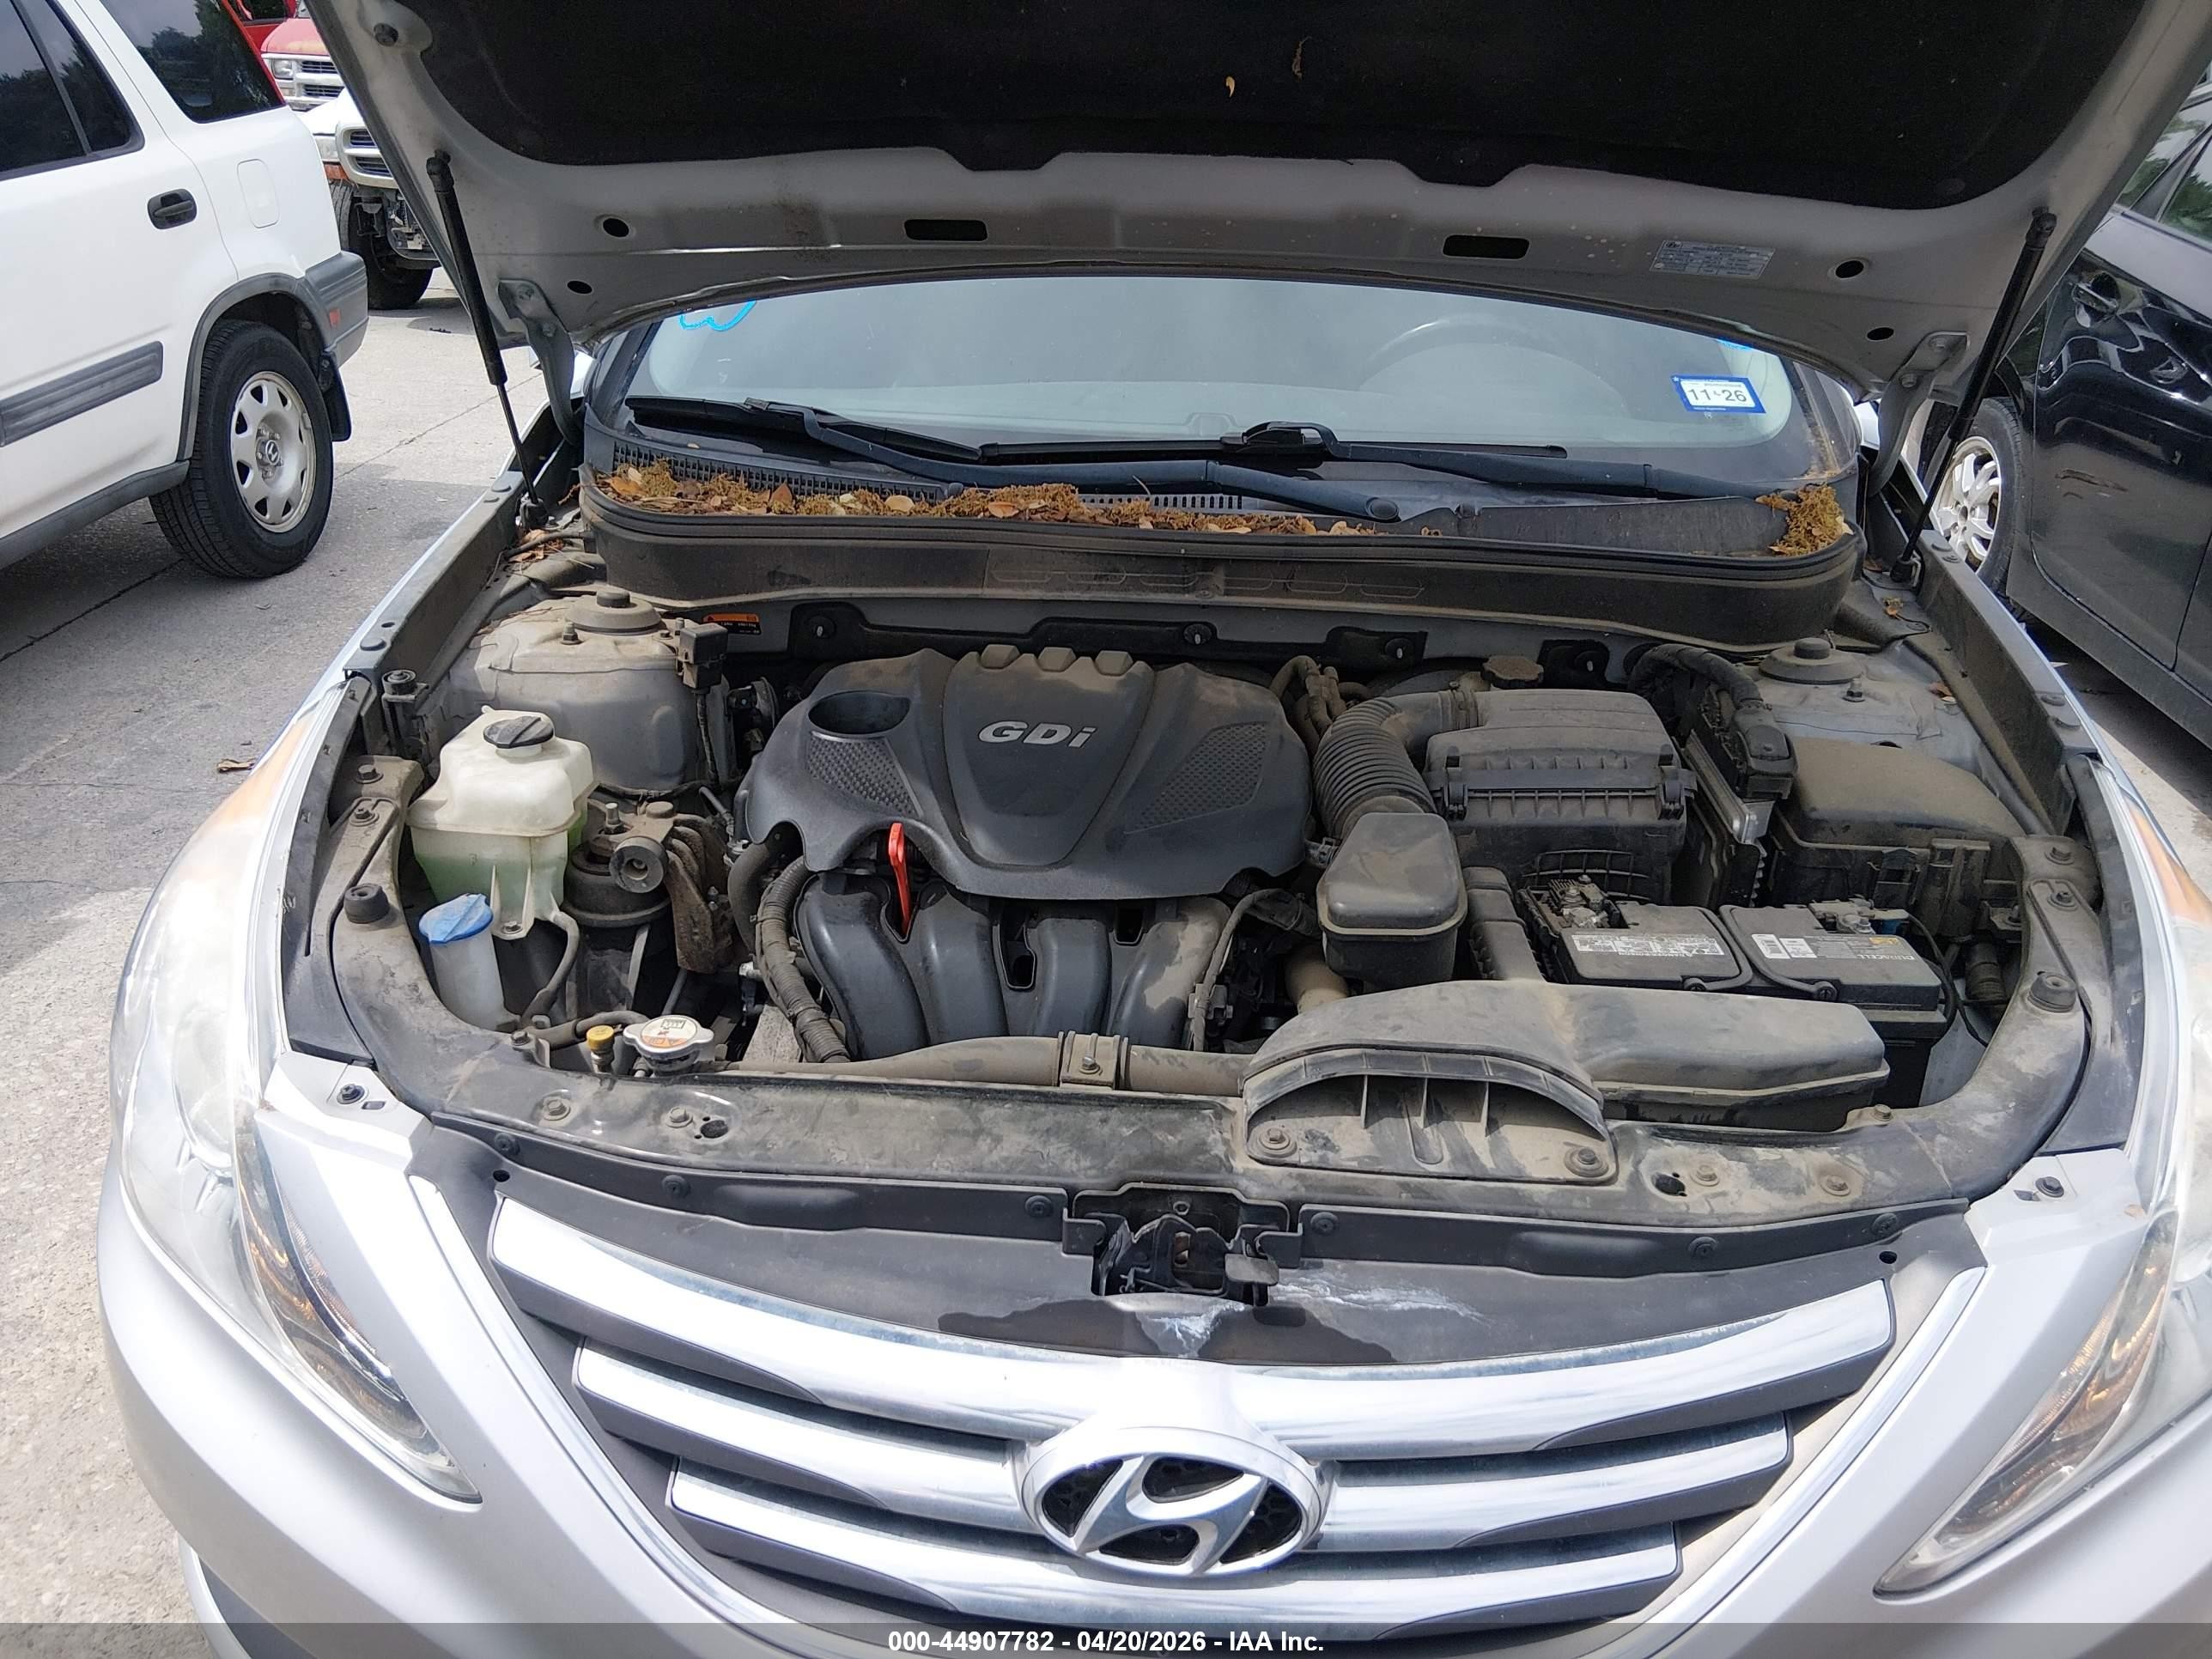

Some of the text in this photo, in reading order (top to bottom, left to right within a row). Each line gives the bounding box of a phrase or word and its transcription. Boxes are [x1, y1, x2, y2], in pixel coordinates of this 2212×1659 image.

[1688, 389, 1747, 402] 11 26
[978, 720, 1097, 748] GDi
